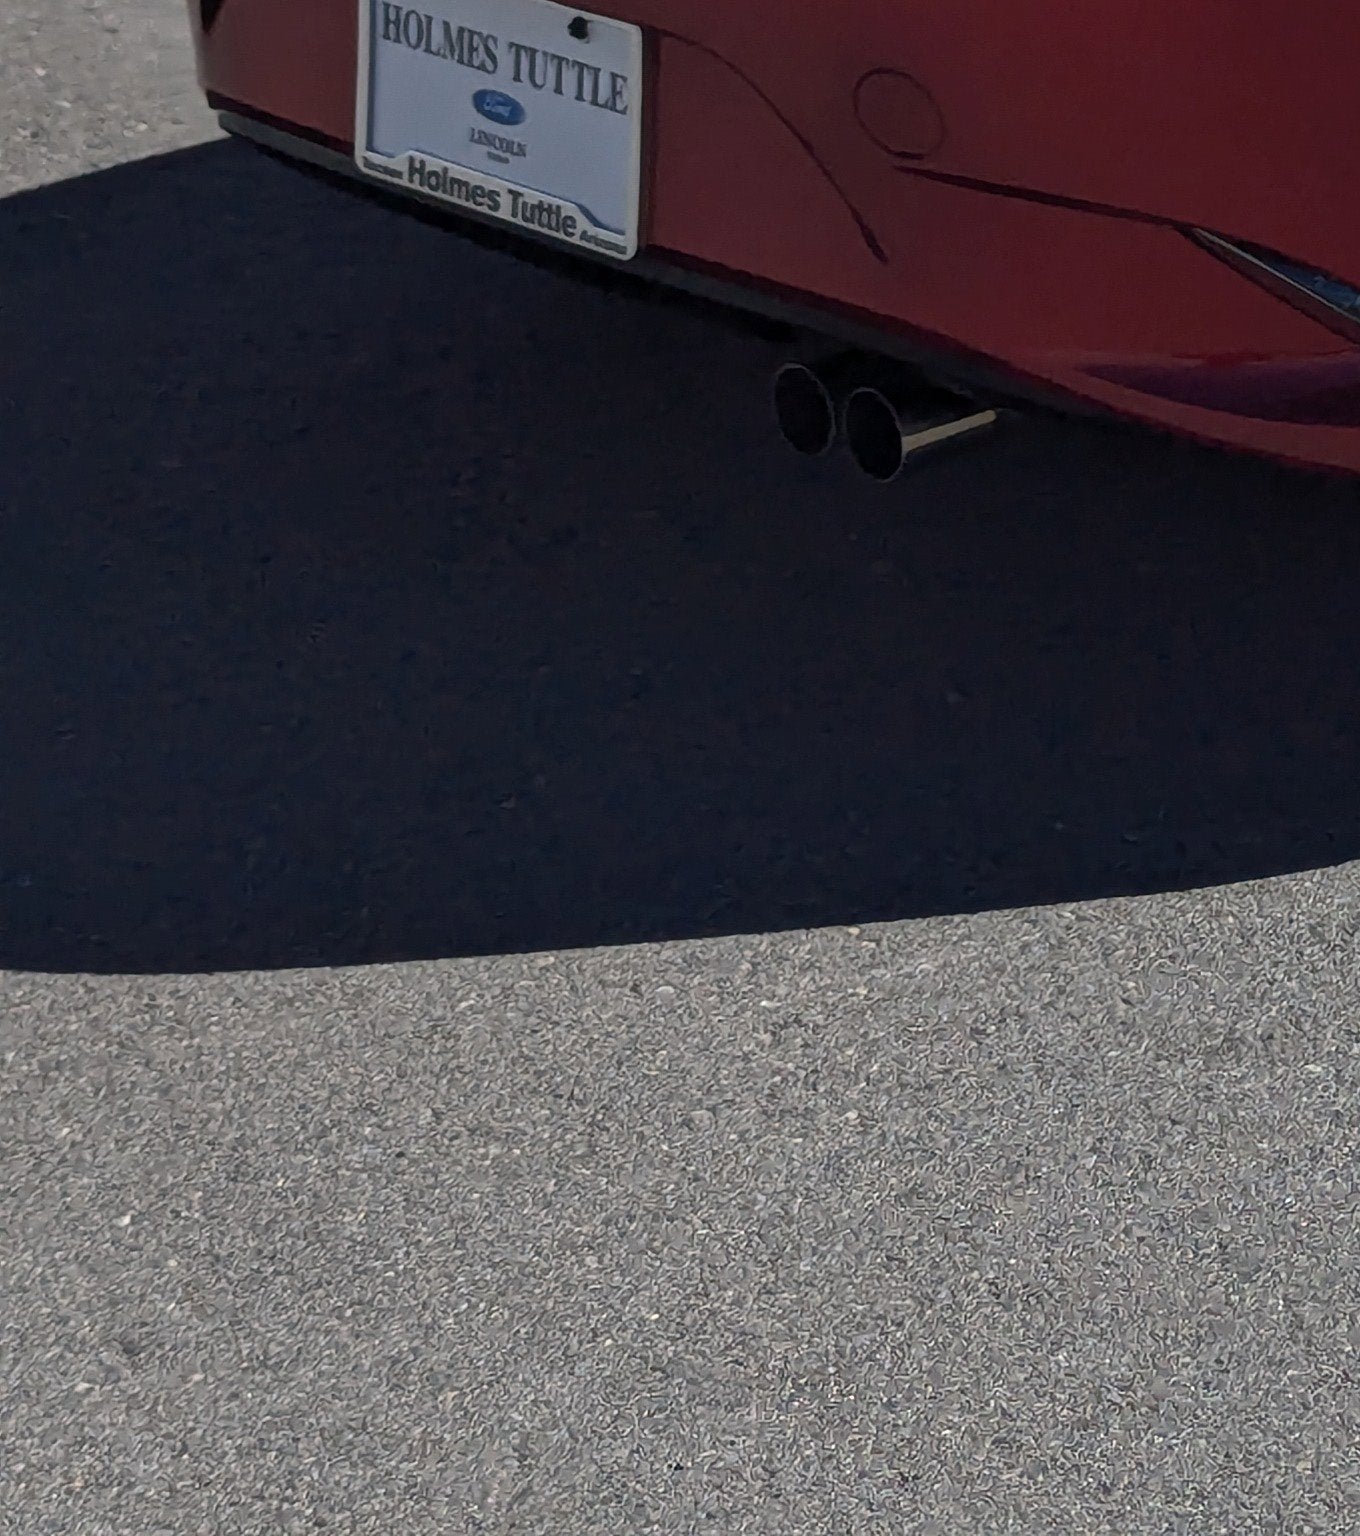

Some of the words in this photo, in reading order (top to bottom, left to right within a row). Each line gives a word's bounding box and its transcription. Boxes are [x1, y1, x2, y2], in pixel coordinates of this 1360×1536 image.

[382, 2, 499, 75] HOLMES
[508, 41, 628, 115] TUTTLE
[408, 155, 500, 212] Holmes
[507, 189, 577, 237] Tuttle
